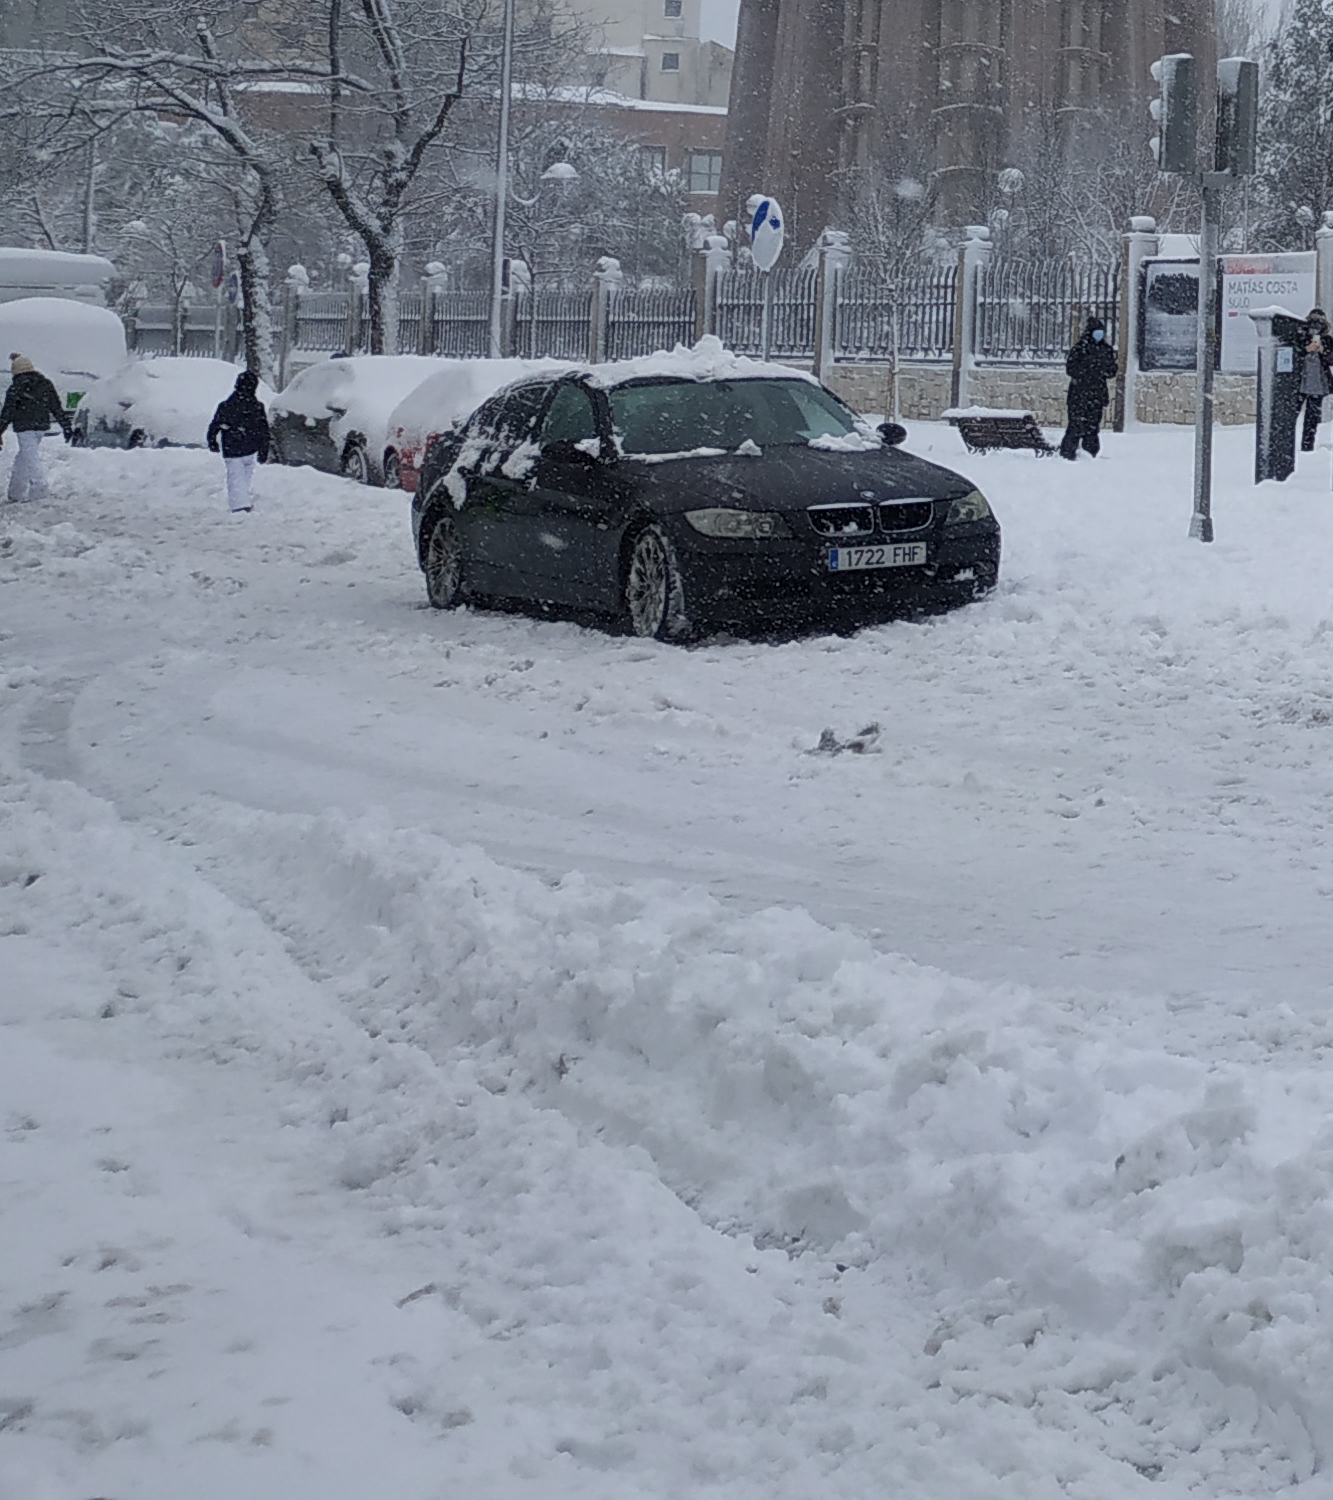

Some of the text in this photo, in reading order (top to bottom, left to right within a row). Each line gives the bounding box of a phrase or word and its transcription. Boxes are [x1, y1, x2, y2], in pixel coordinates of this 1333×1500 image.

[1265, 281, 1298, 294] COSTA
[1228, 297, 1250, 308] SOLO
[846, 546, 923, 567] 1722 FHF
